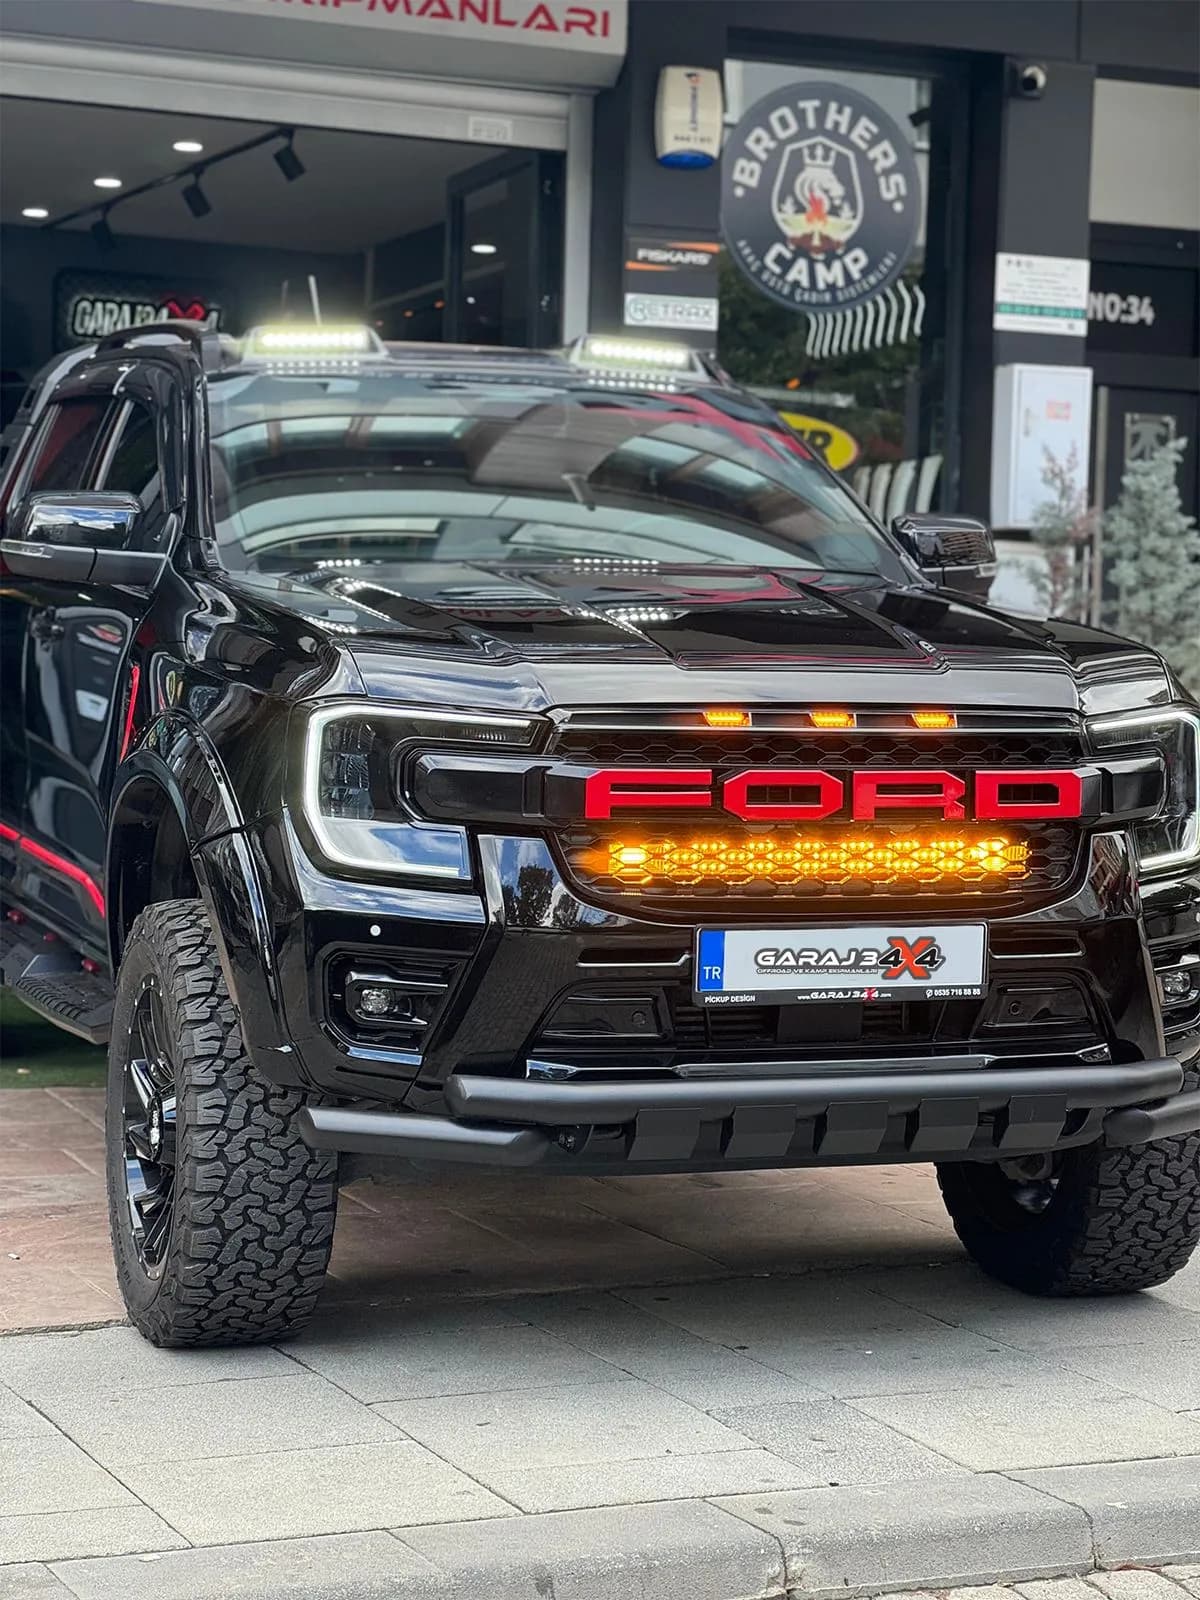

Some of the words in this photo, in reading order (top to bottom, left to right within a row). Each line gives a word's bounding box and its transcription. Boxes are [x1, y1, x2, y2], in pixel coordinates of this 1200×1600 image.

[268, 0, 609, 37] MANLARI
[732, 99, 907, 201] BROTHERS
[637, 248, 712, 265] FISKARS
[763, 242, 869, 290] CAMP
[1087, 293, 1155, 326] NO:34
[585, 768, 1082, 822] FORD
[703, 966, 721, 980] TR
[757, 967, 792, 975] OFFROAD
[793, 967, 804, 975] VE
[804, 967, 827, 975] KAMP
